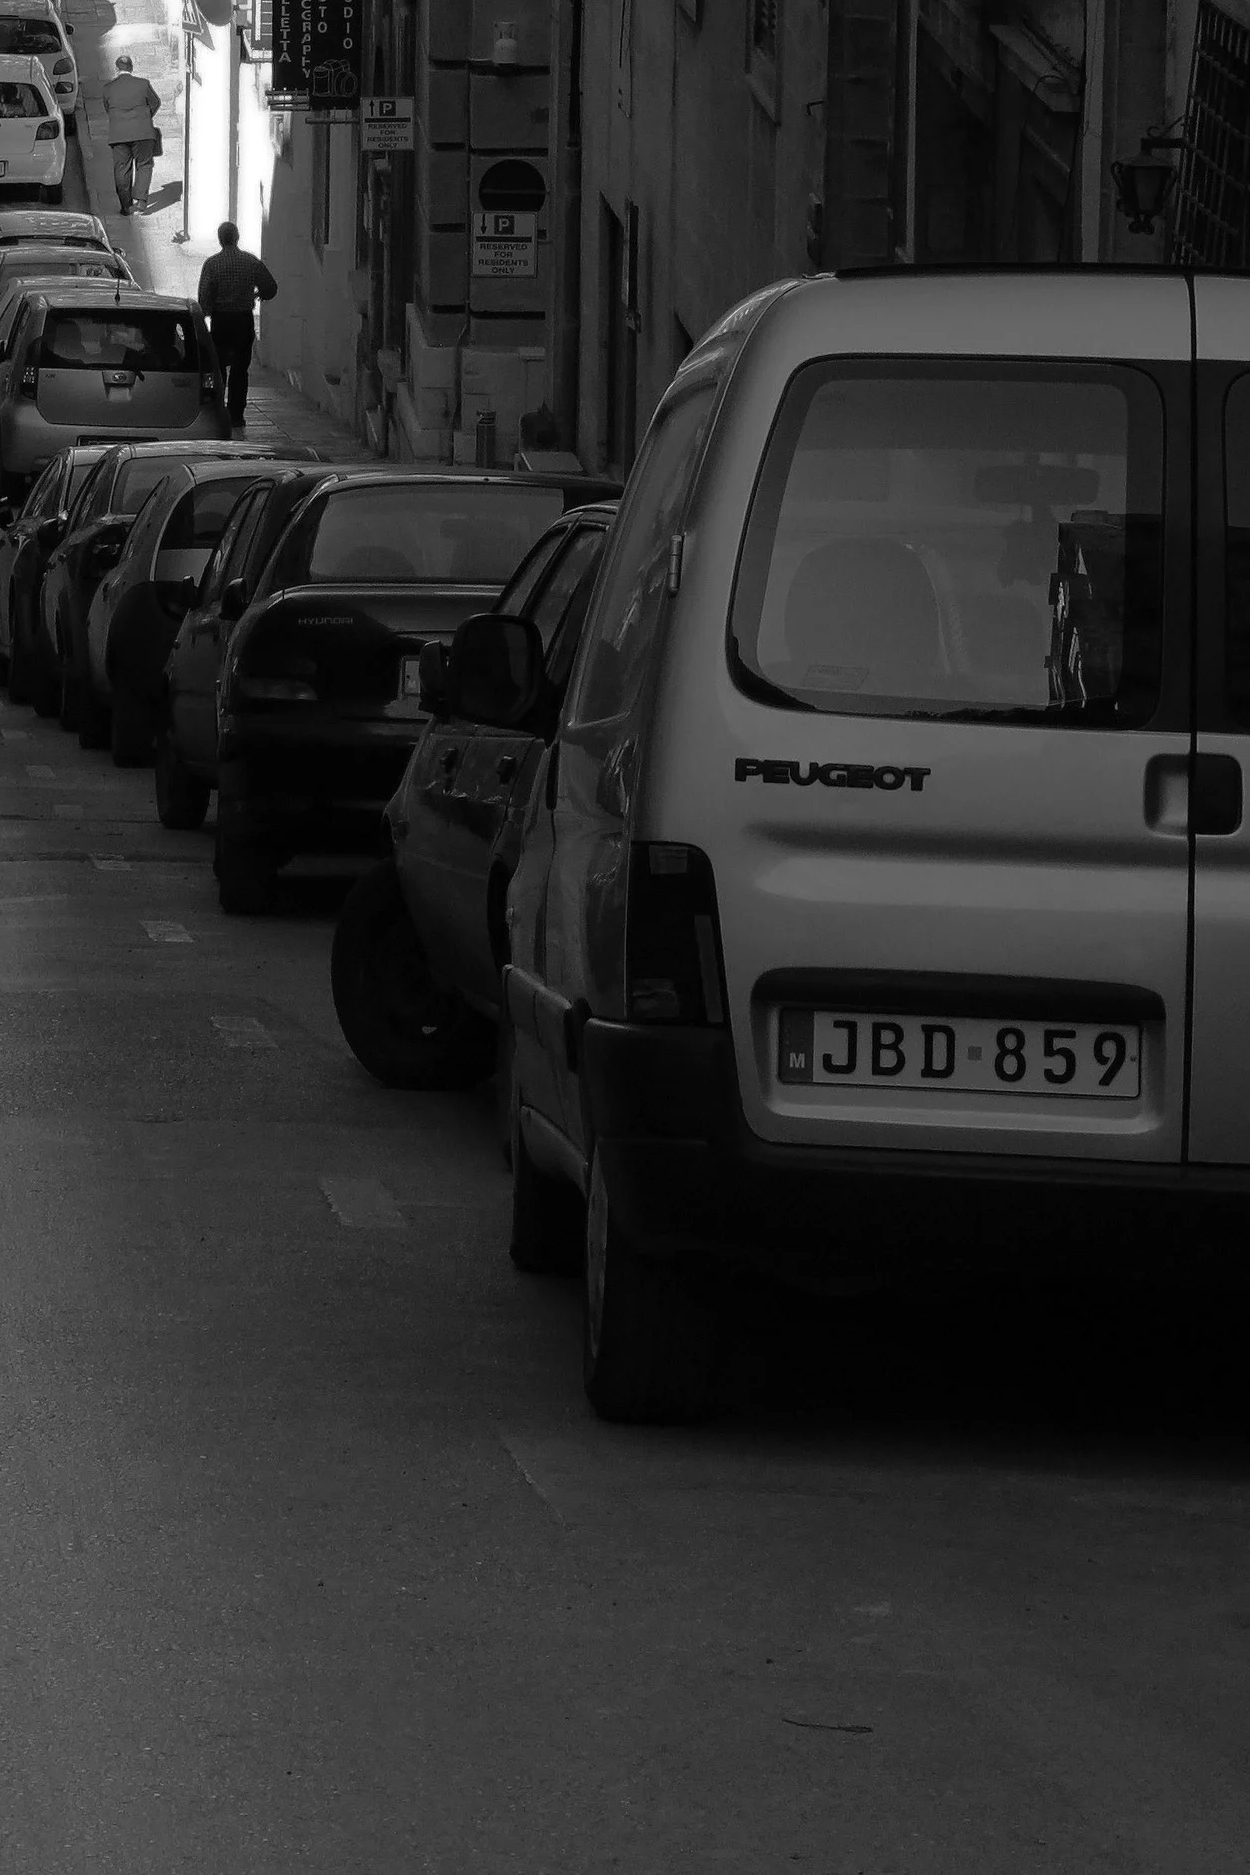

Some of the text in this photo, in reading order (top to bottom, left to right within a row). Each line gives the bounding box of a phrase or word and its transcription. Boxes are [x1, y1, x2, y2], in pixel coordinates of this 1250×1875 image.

[383, 103, 393, 114] P
[498, 218, 510, 232] P
[480, 243, 528, 251] RESERVED
[478, 259, 529, 267] RESIDENTS
[492, 266, 515, 275] ONLY
[298, 617, 354, 626] HYUNDAI
[735, 757, 931, 792] PEUGEOT
[789, 1052, 805, 1069] M
